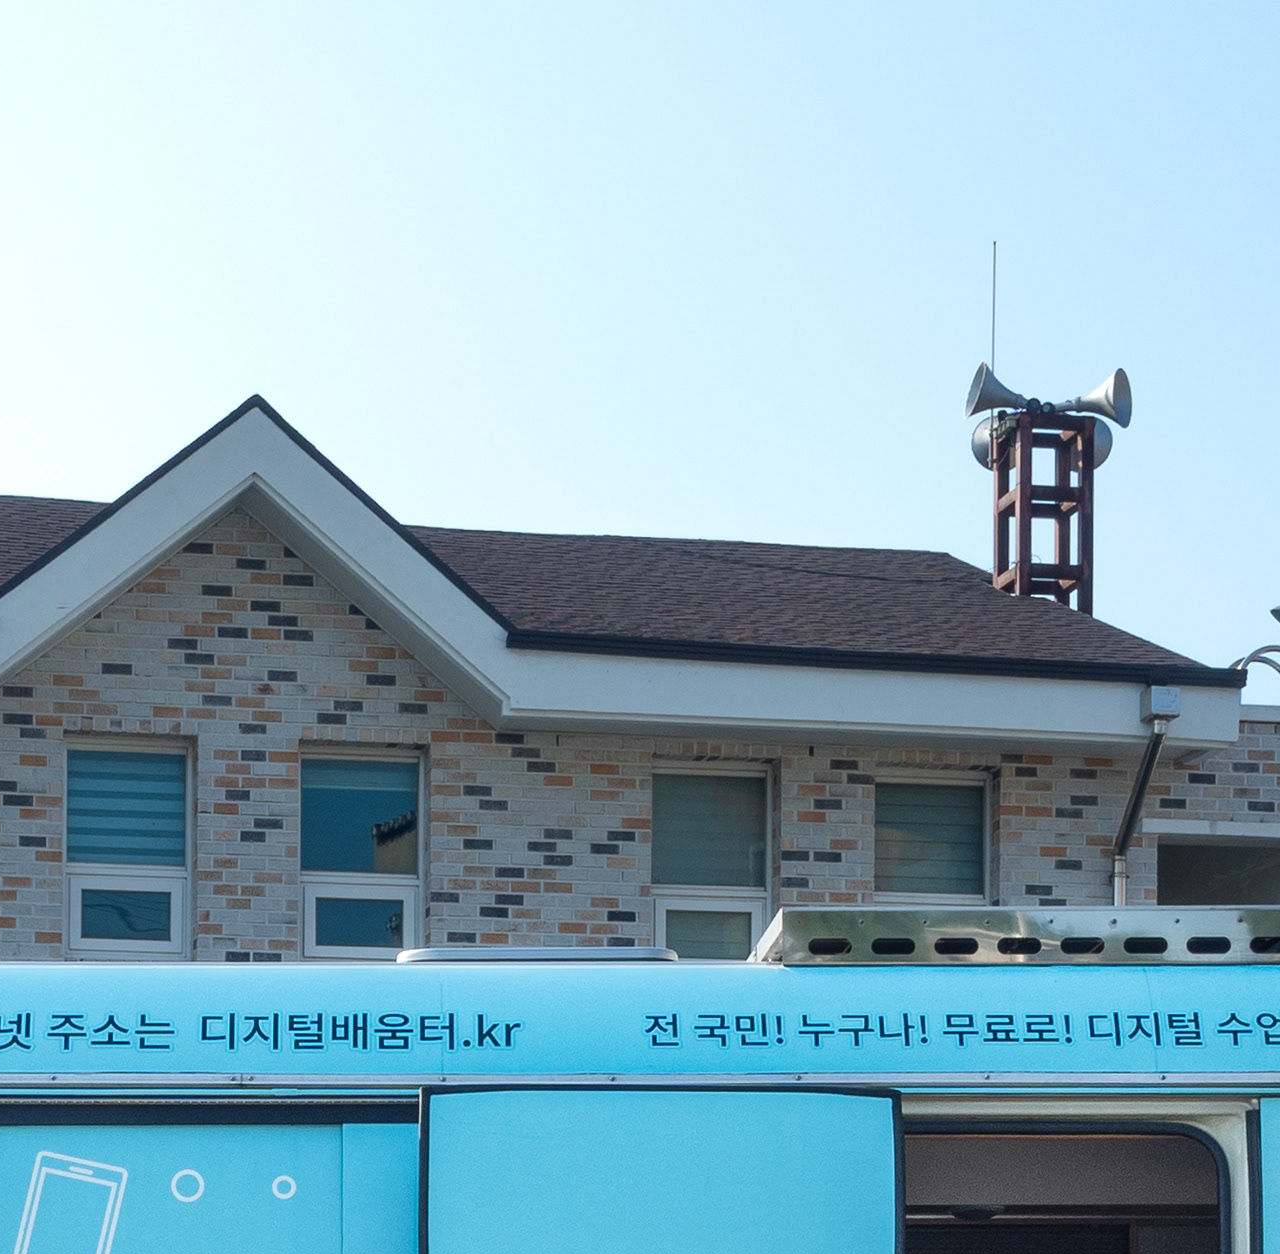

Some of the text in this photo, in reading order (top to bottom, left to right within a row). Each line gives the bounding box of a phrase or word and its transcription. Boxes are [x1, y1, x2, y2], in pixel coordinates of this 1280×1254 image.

[46, 1013, 175, 1051] 주소는
[201, 1012, 521, 1051] 디지털배움터.kr
[644, 1013, 680, 1047] 전
[693, 1013, 784, 1047] 국민!
[798, 1012, 929, 1047] 누구나!
[942, 1013, 1073, 1047] 무료로!
[1088, 1011, 1203, 1047] 디지털
